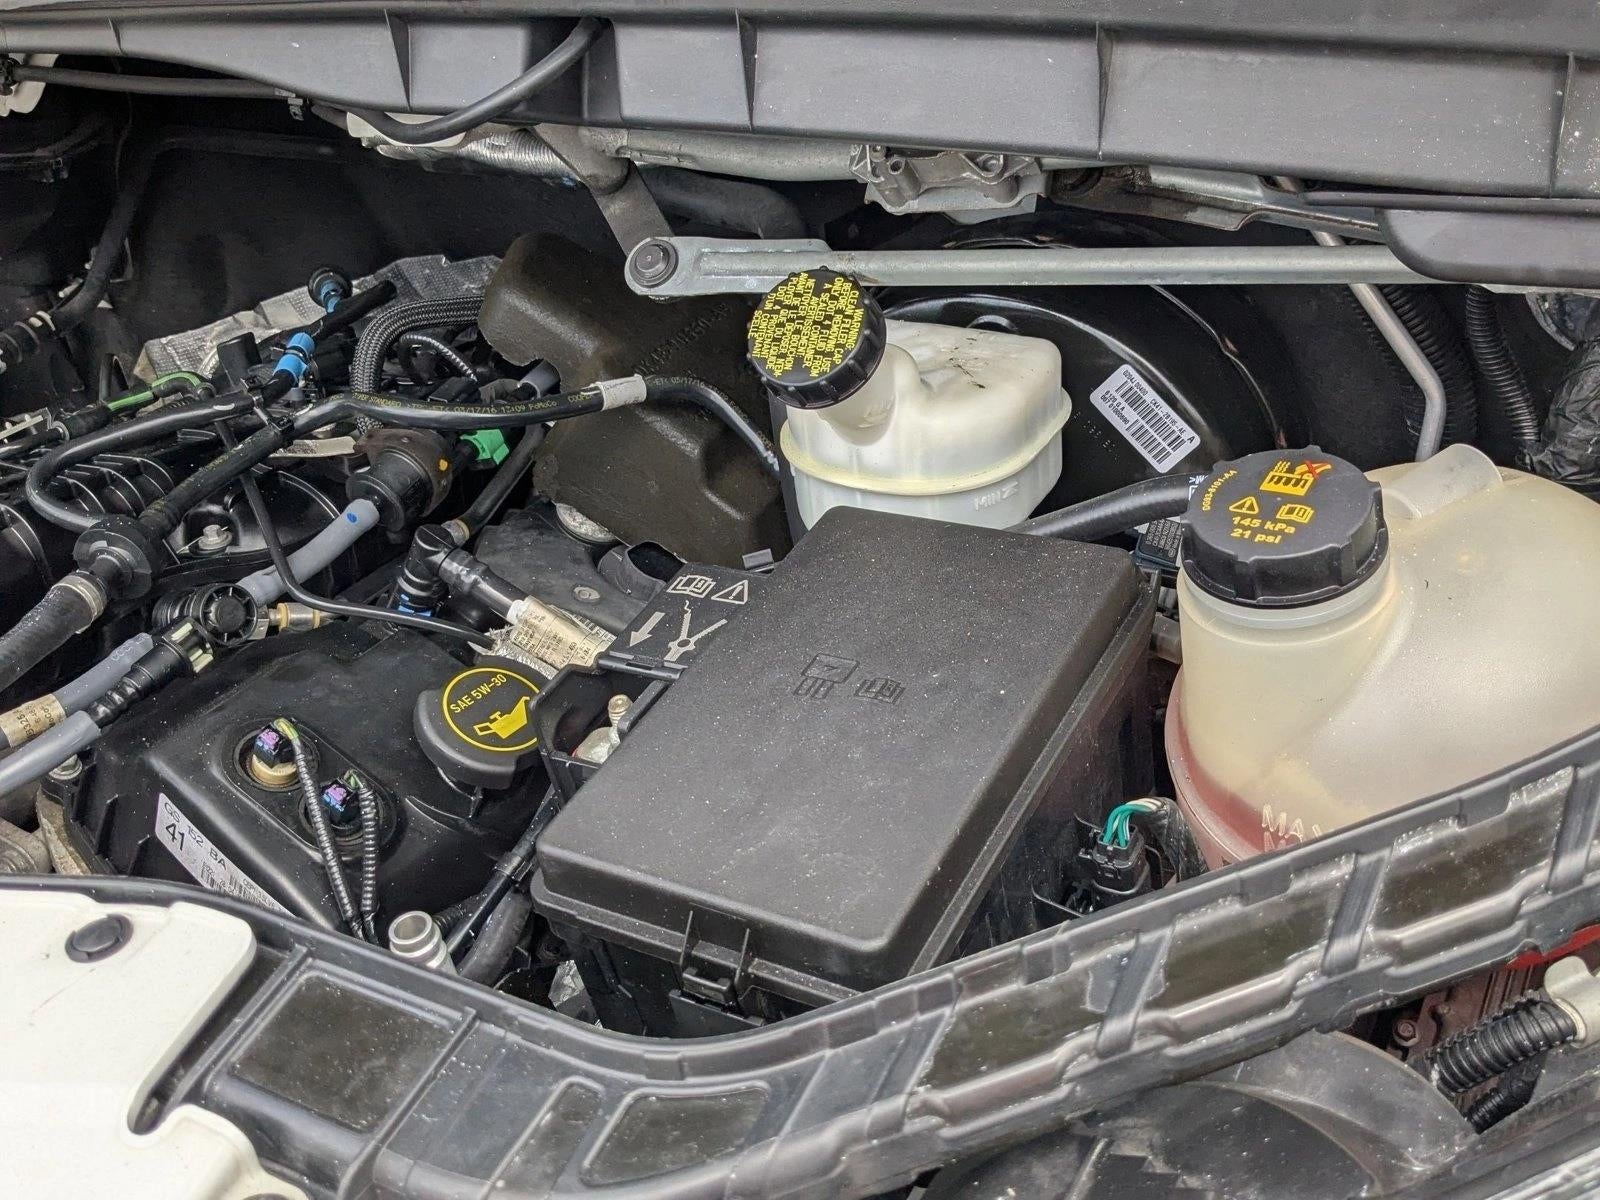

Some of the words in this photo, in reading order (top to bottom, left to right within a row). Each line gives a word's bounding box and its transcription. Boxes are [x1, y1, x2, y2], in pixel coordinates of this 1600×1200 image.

[776, 286, 787, 301] DOT
[783, 277, 798, 305] PLOYER
[795, 272, 808, 294] AVANT
[831, 278, 844, 296] ONLY
[790, 297, 802, 307] DE
[798, 278, 816, 316] NETTOYER
[815, 293, 829, 321] SEALED
[836, 282, 852, 310] BEFORE
[846, 291, 859, 314] CLEAN
[778, 309, 788, 324] QUE
[788, 310, 796, 319] LE
[826, 300, 838, 316] DOT
[748, 310, 763, 338] SCELLE
[774, 327, 784, 338] DU
[795, 319, 804, 330] LE
[838, 318, 851, 344] FILLER
[752, 313, 770, 358] CONTENANT
[760, 314, 778, 358] PROVENANT
[816, 330, 830, 351] FLUID
[766, 342, 780, 369] LIQUIDE
[784, 335, 800, 370] BOUCHON
[833, 348, 844, 364] CAP
[810, 355, 824, 377] FROM
[820, 357, 832, 372] USE
[1230, 528, 1252, 539] 21
[1255, 533, 1282, 544] psi
[1232, 516, 1261, 528] 145
[1264, 521, 1296, 534] kPa
[450, 695, 474, 713] SAE
[471, 674, 507, 700] 5W-30
[164, 802, 181, 823] GS
[209, 849, 227, 871] BA
[166, 823, 186, 851] 41
